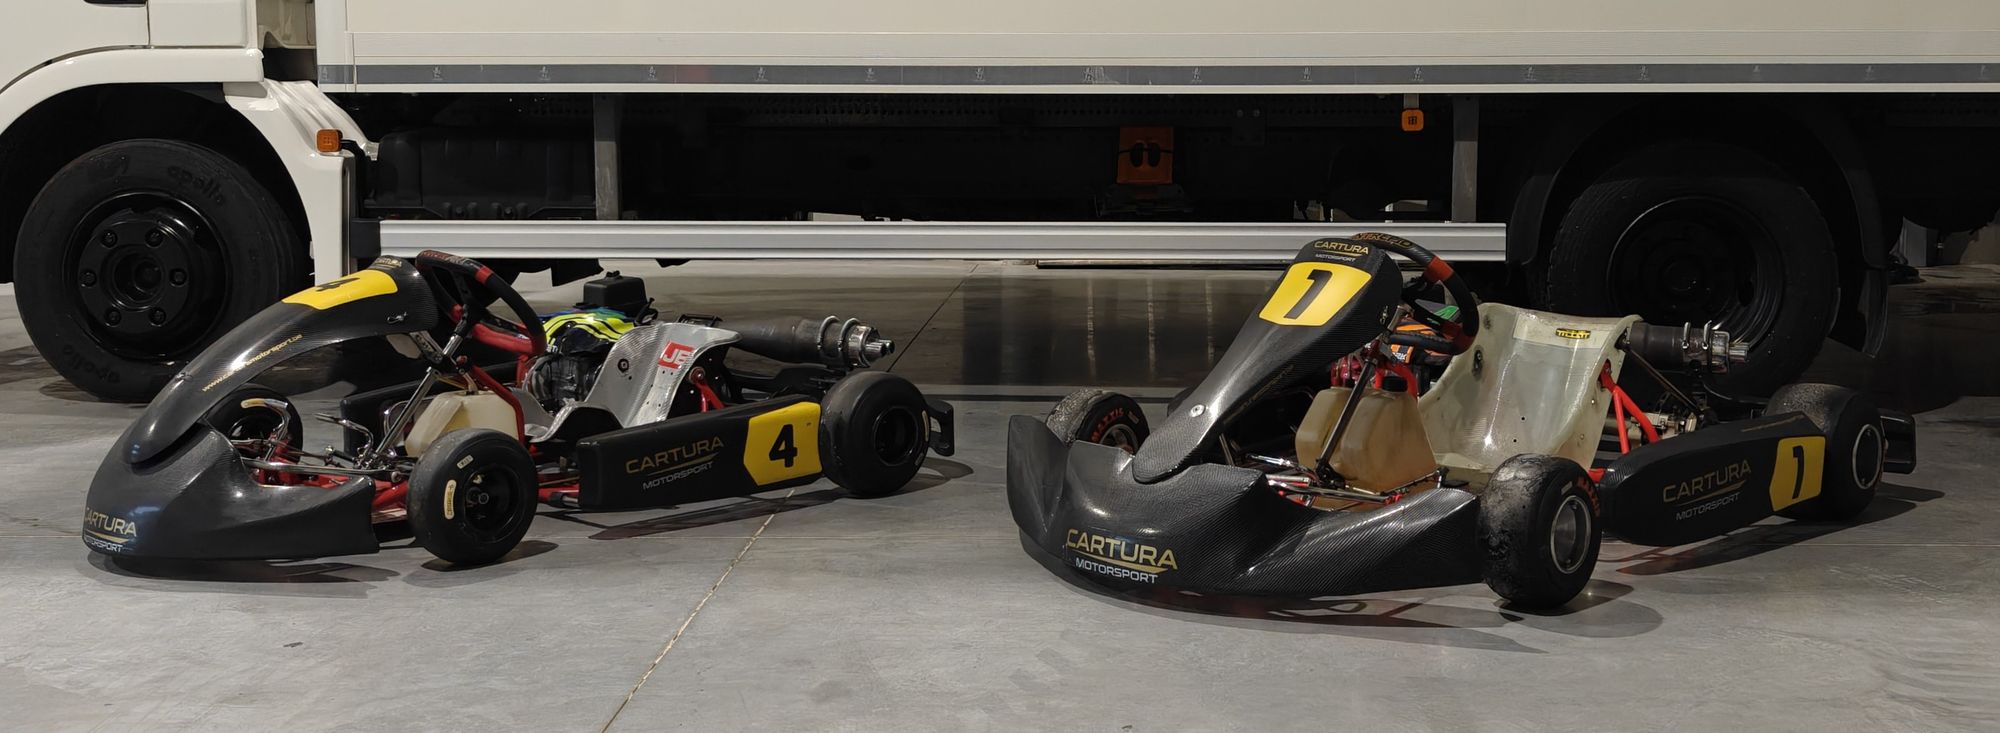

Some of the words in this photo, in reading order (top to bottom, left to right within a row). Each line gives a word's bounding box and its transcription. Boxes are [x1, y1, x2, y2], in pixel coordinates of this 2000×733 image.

[1314, 240, 1369, 255] CARTURA
[1315, 253, 1356, 262] MOTORSPORT
[1283, 269, 1333, 319] 1
[201, 333, 303, 392] www.carramotorsport.be
[625, 436, 724, 474] CARTURA
[768, 423, 798, 468] 4
[642, 461, 714, 490] MOTORSPORT
[1663, 459, 1752, 503] CARTURA
[1792, 446, 1805, 500] 1
[85, 506, 137, 538] ARTURA
[1676, 492, 1741, 520] MOTORSPORT
[84, 534, 124, 553] RSPORT
[1066, 528, 1178, 570] CARTURA
[1075, 557, 1159, 584] MOTORSPORT
